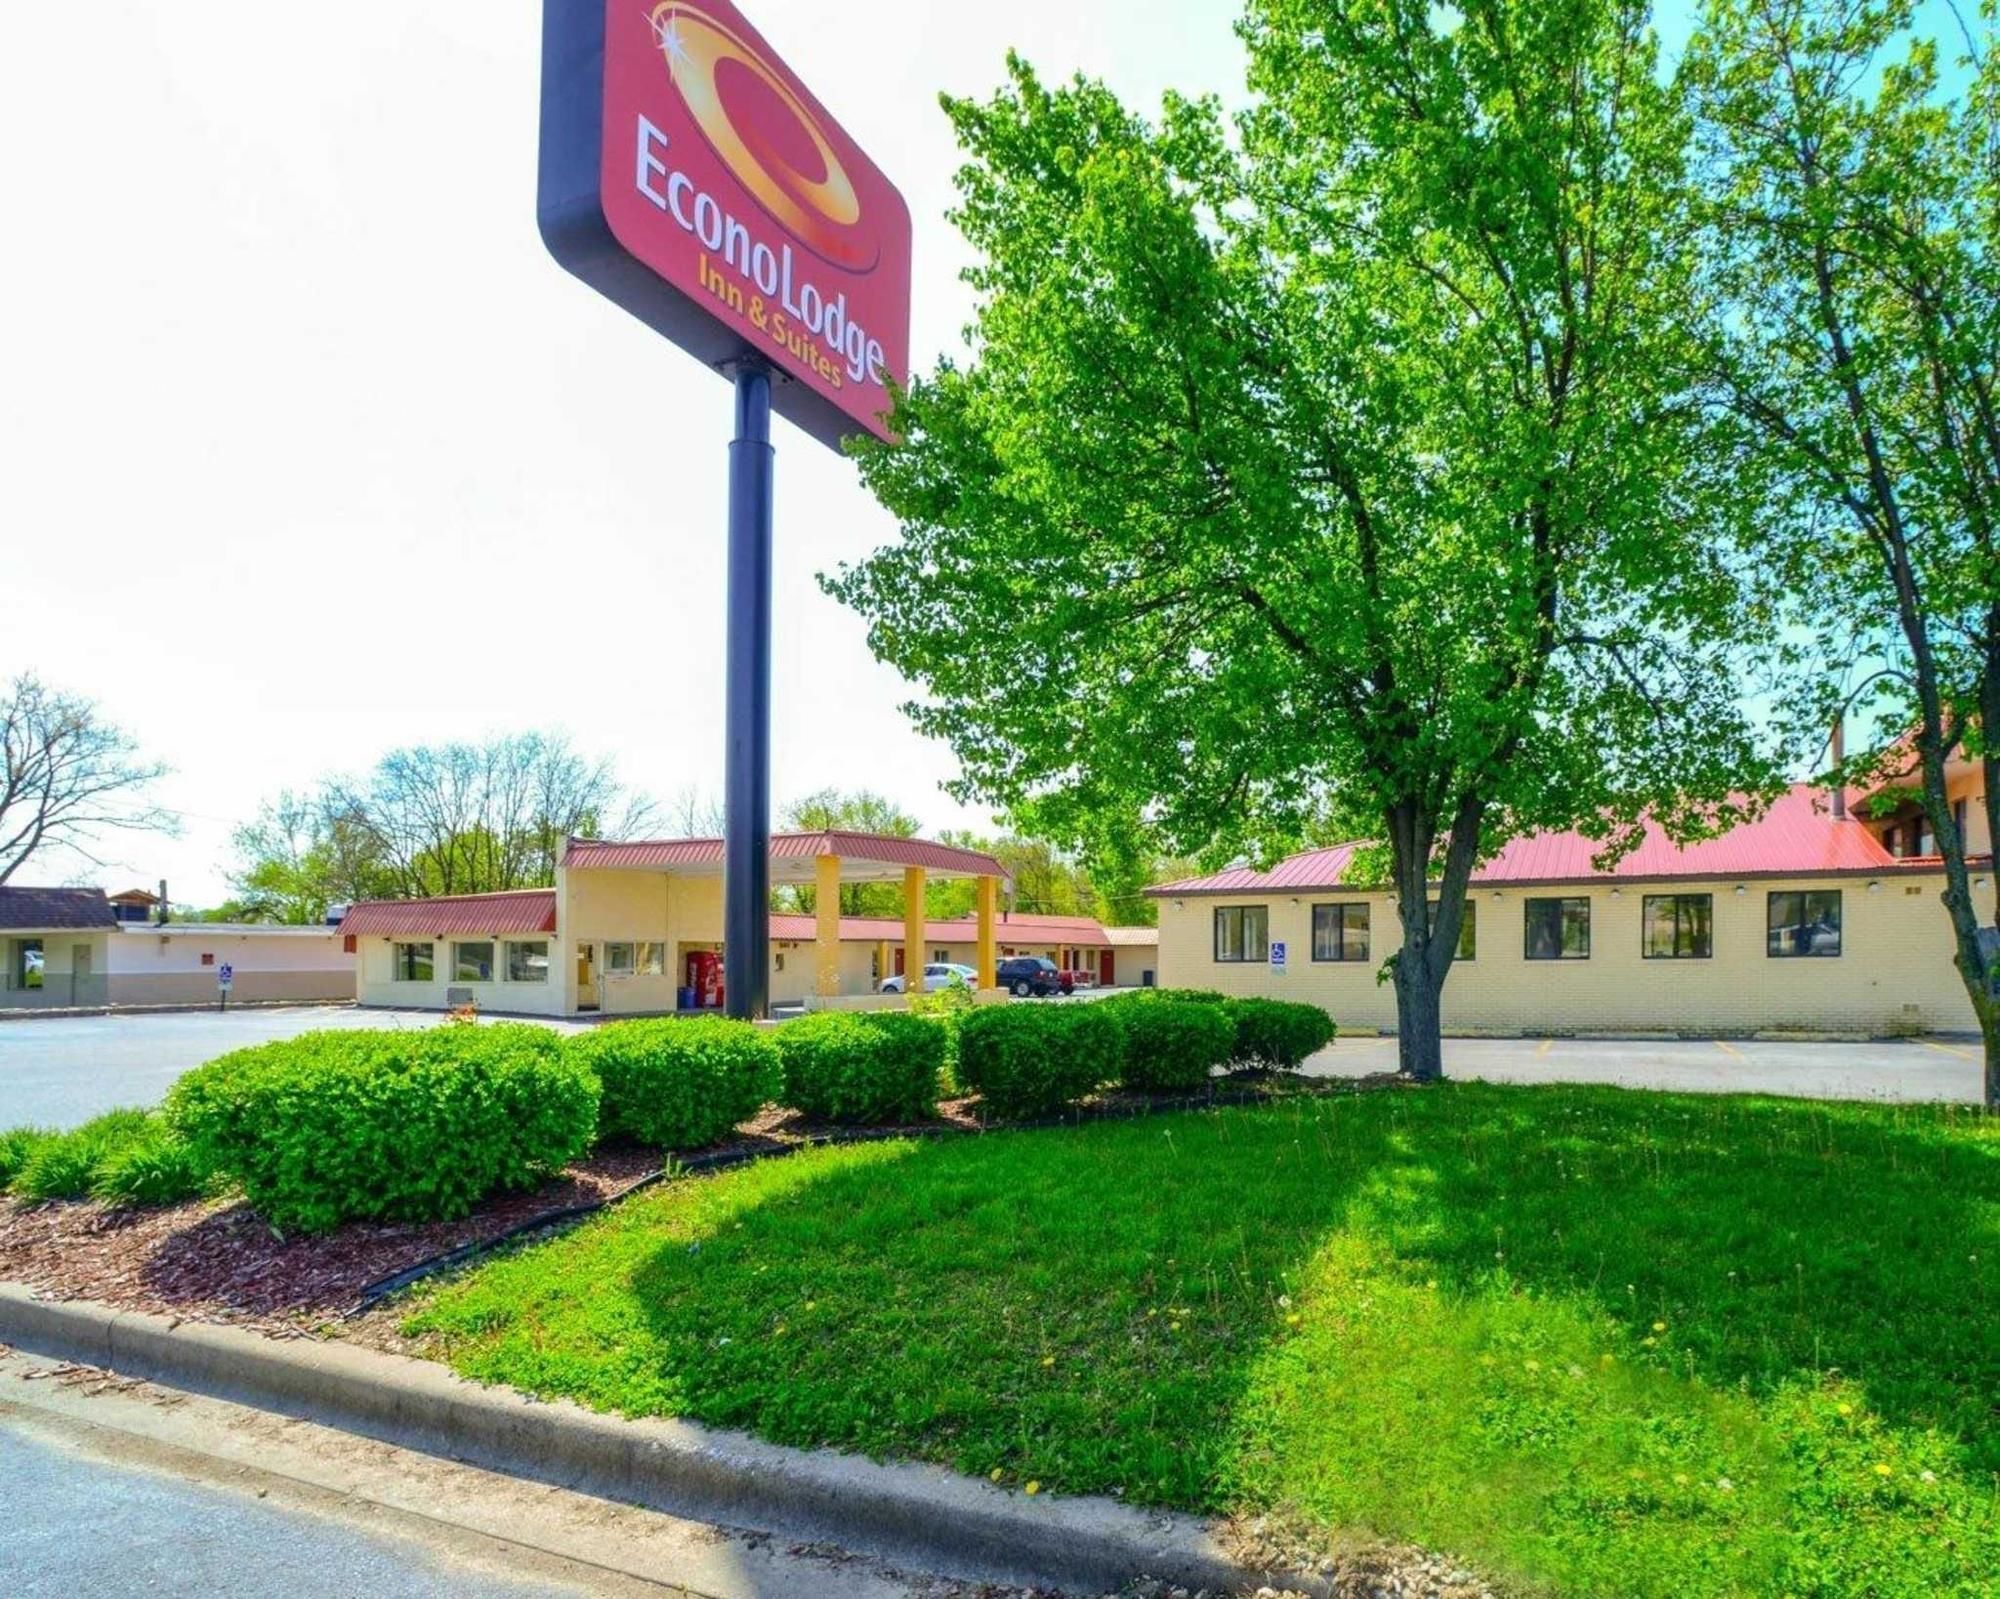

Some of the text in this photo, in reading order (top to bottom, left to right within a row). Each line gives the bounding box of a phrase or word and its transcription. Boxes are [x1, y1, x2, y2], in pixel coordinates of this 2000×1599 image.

[699, 252, 843, 389] Inn & Suites
